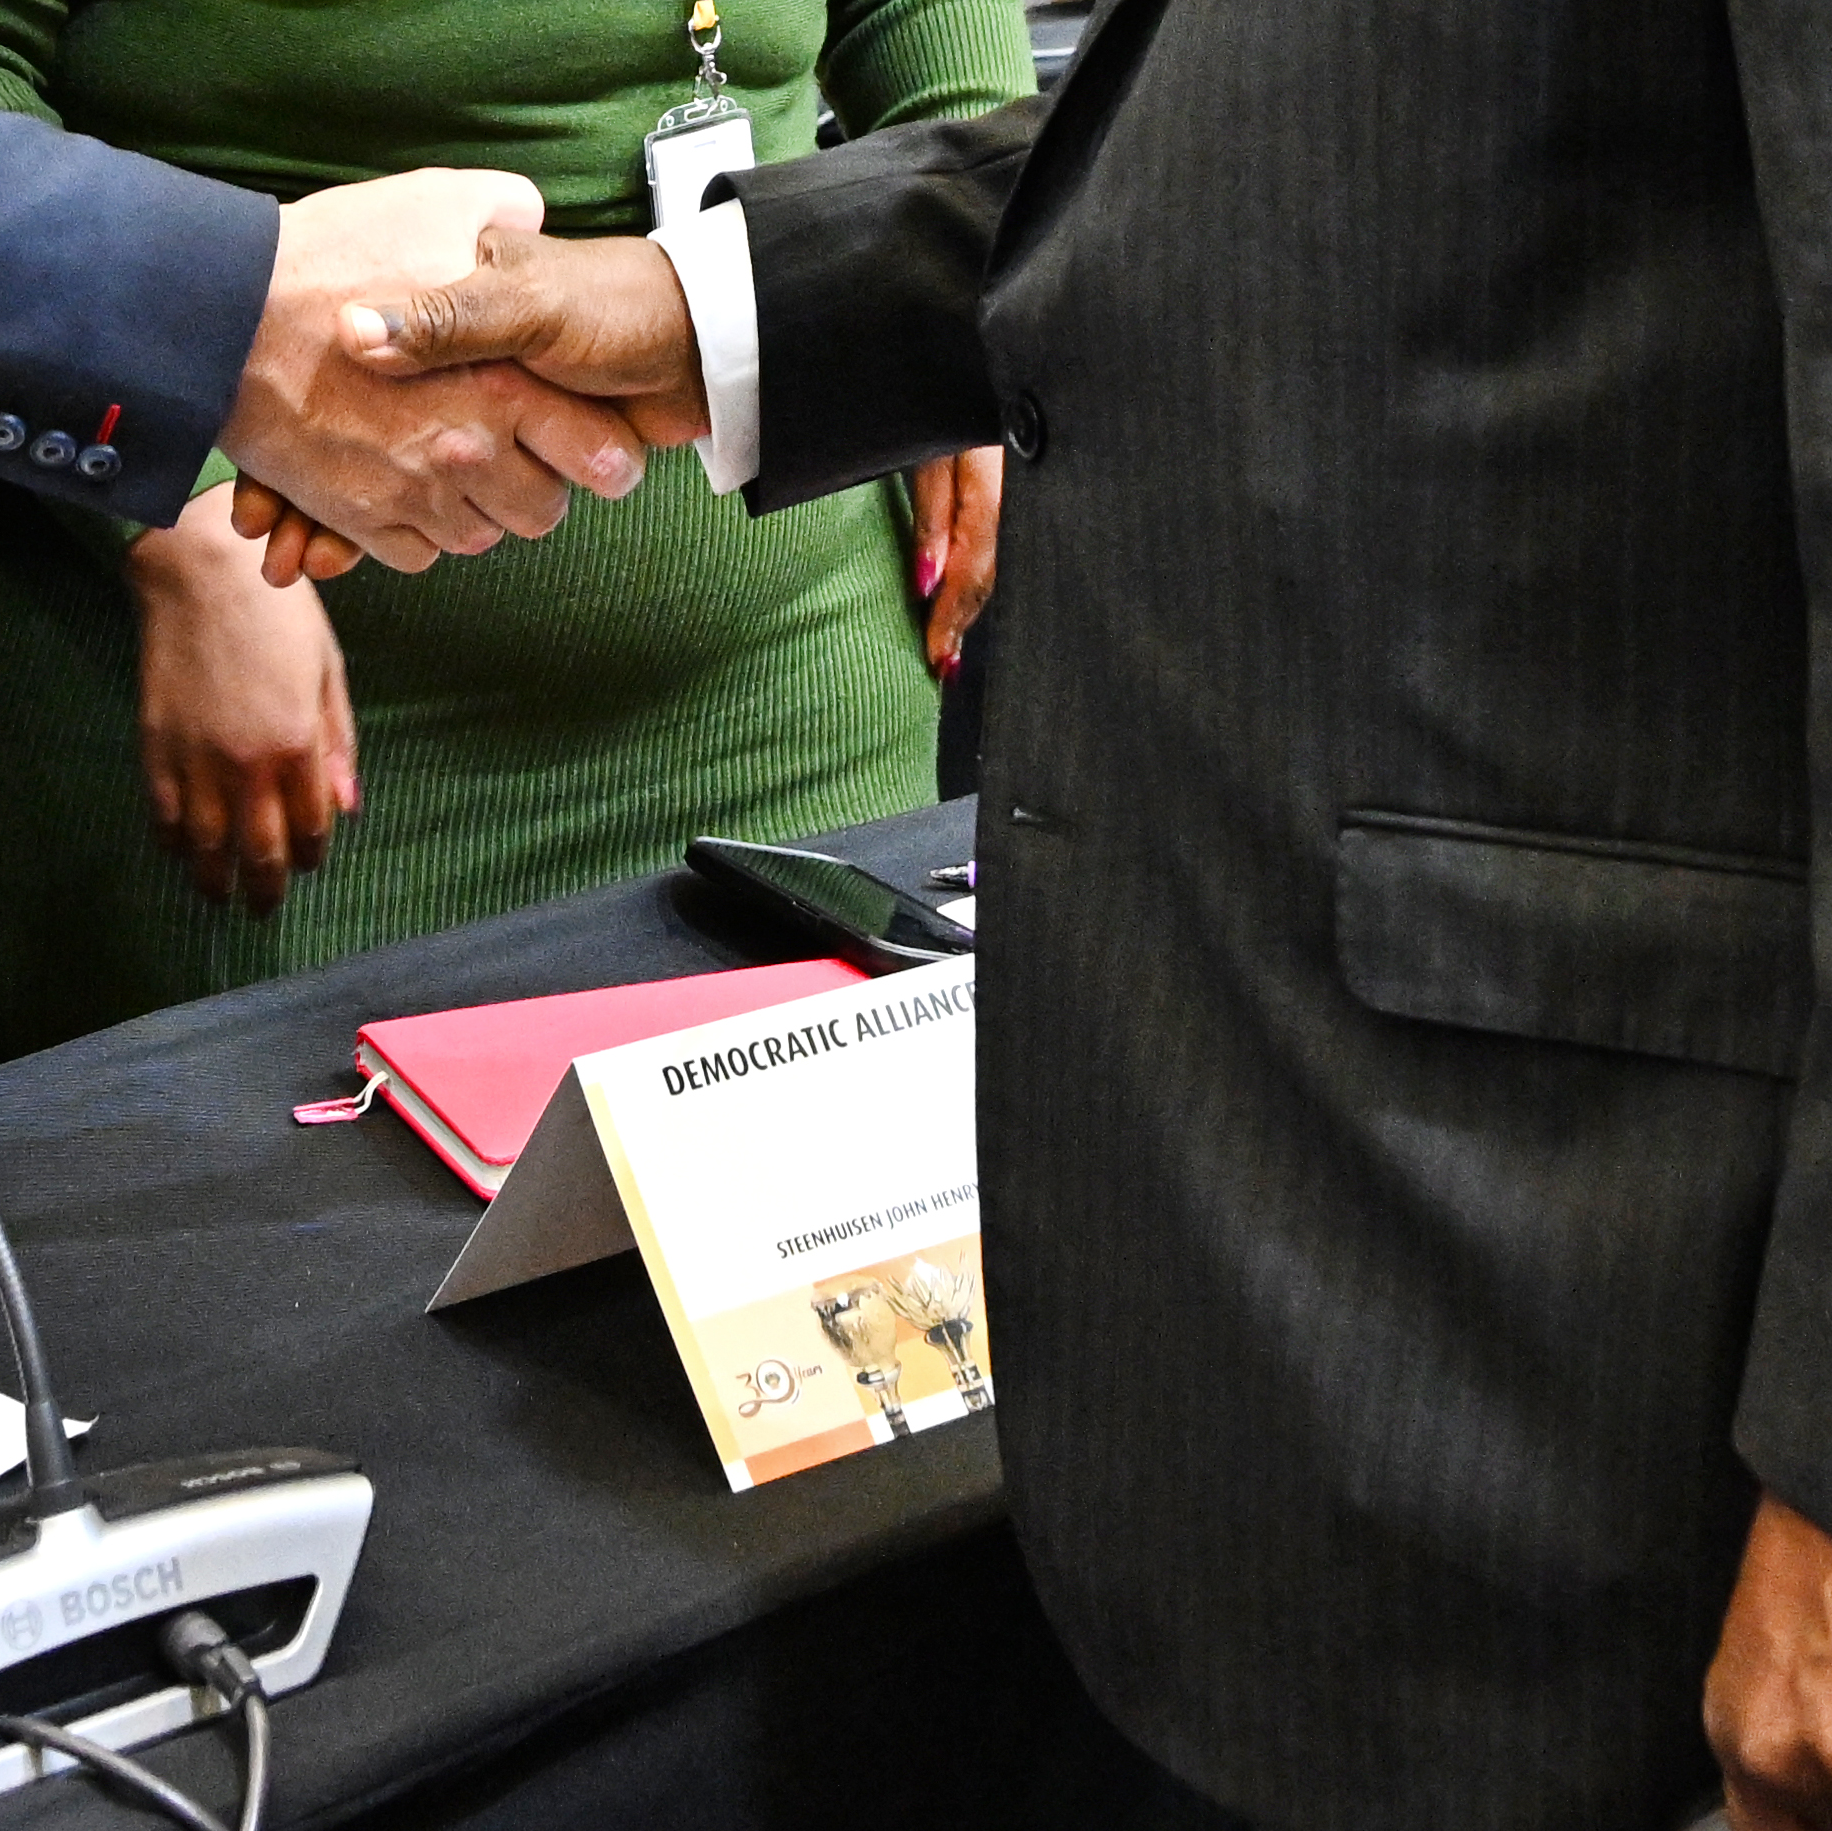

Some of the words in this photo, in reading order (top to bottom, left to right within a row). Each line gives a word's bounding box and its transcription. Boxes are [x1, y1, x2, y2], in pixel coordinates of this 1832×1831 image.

[661, 1019, 848, 1097] DEMOCRATIC
[776, 1211, 884, 1259] STEENHUISEN
[886, 1198, 929, 1230] JOHN
[59, 1556, 184, 1628] BOSCH
